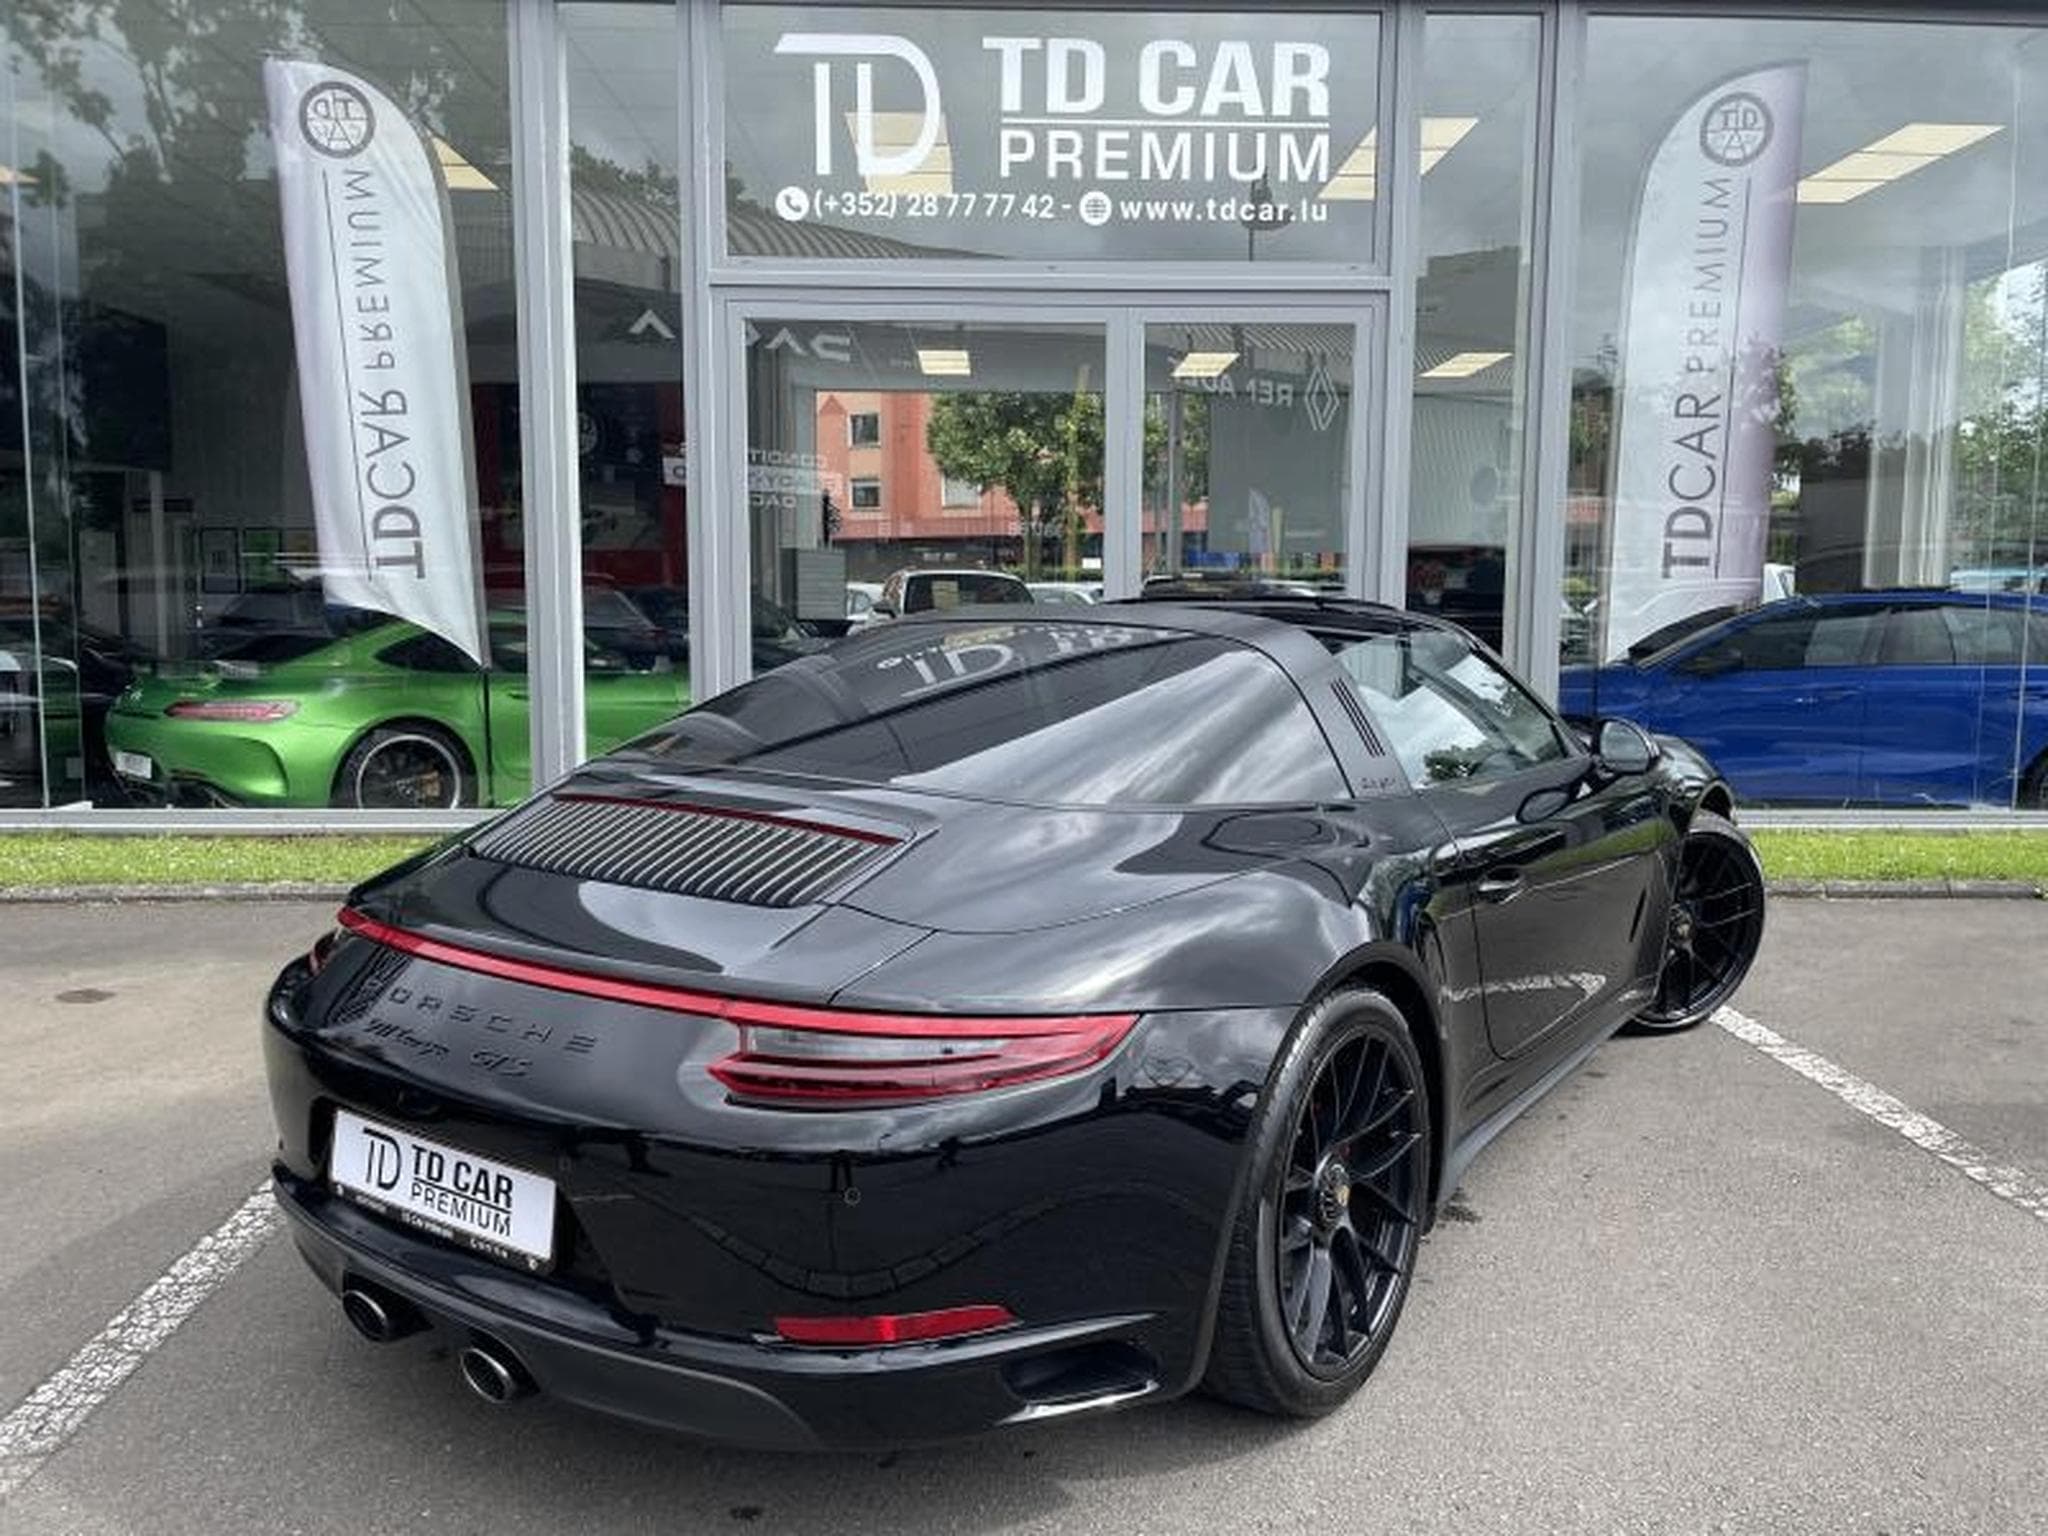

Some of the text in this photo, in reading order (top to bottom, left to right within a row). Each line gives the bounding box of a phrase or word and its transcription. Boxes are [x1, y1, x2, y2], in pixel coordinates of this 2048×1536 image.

[982, 37, 1331, 118] TD CAR
[1001, 130, 1331, 183] PREMIUM
[813, 188, 897, 219] (+352)
[906, 194, 939, 217] 28
[948, 194, 977, 218] 77
[984, 194, 1016, 218] 77
[1020, 194, 1055, 219] 42
[1119, 197, 1328, 222] www.tdcar.lu
[1661, 177, 1732, 579] TDCAR PREMIUM
[411, 1143, 513, 1209] TD CAR
[411, 1182, 512, 1237] PREMIUM
